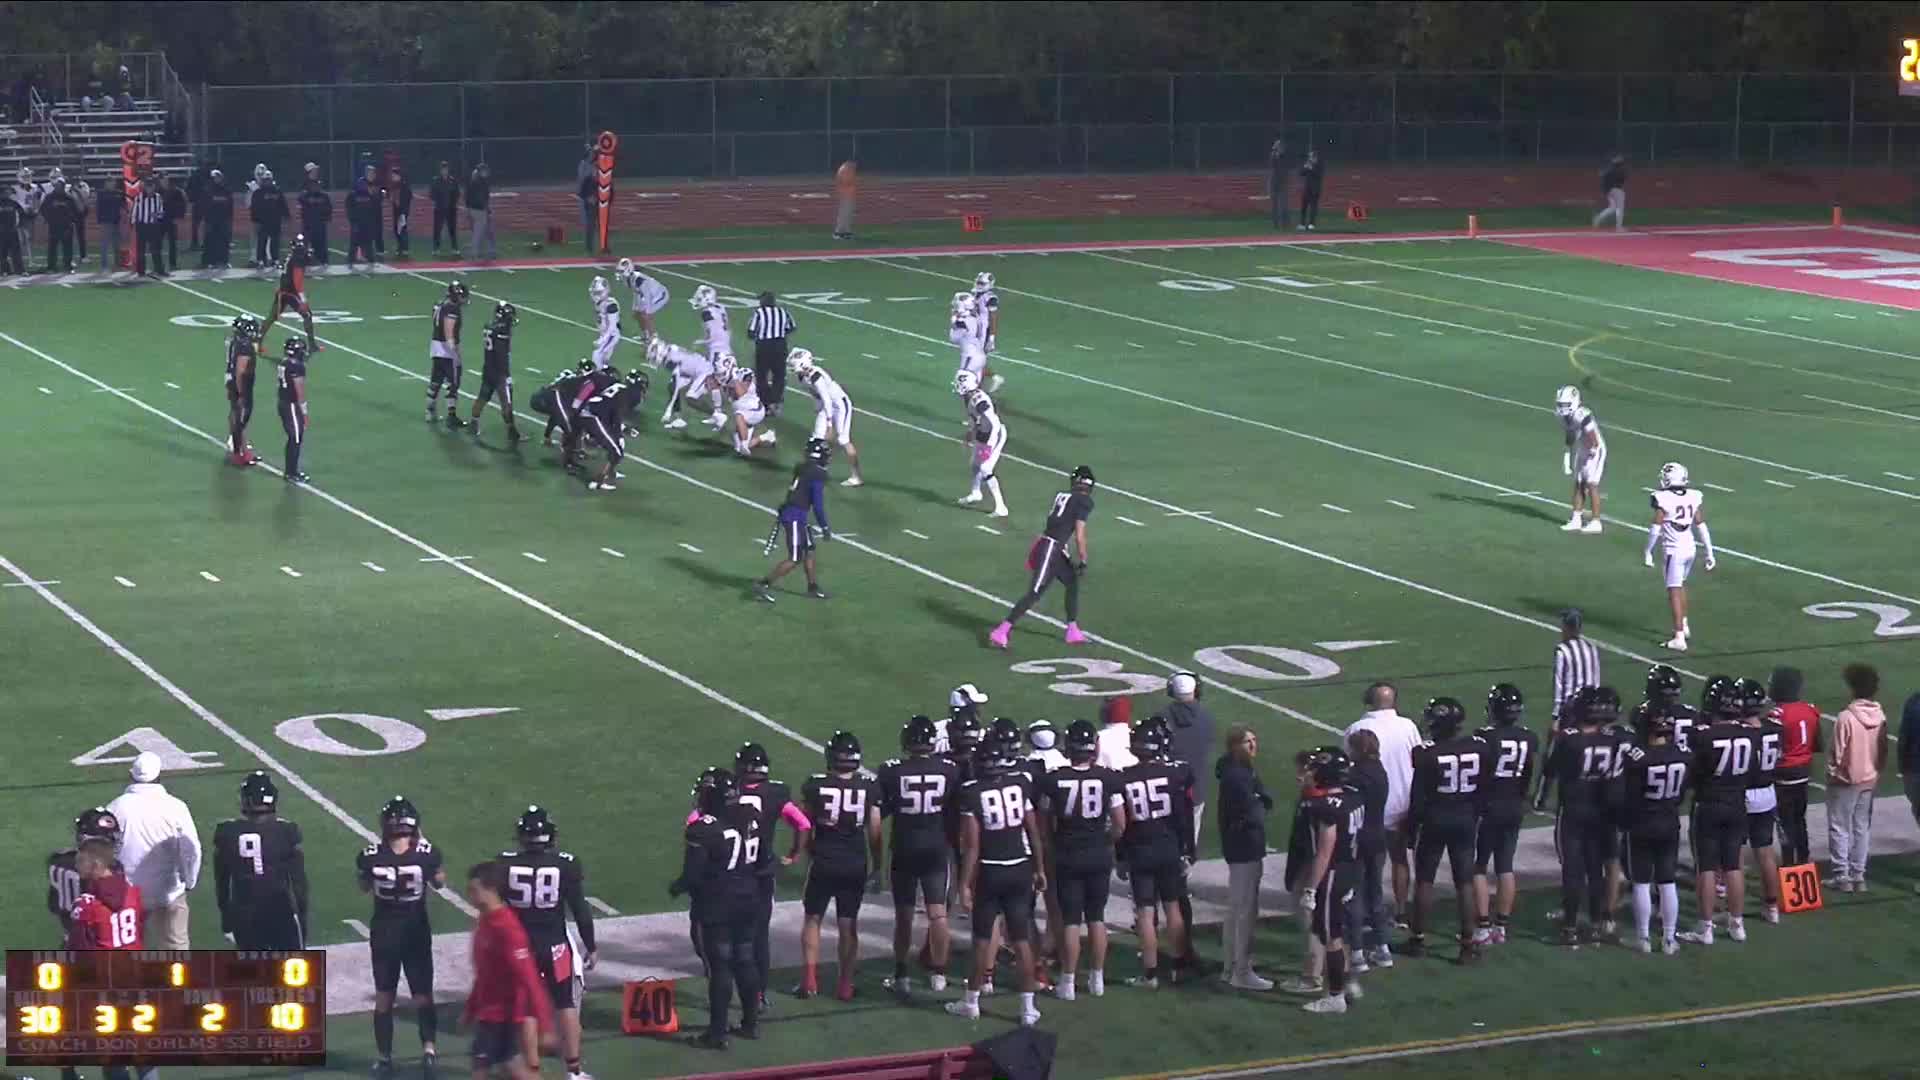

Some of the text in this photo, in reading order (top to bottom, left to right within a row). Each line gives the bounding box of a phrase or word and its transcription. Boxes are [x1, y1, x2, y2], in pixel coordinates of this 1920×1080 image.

[1901, 39, 1920, 81] 2
[1799, 719, 1808, 745] 1
[1437, 752, 1480, 793] 32
[1495, 740, 1529, 777] 21
[1712, 737, 1751, 776] 70
[900, 774, 946, 815] 52
[1057, 778, 1103, 819] 78
[1125, 777, 1172, 821] 85
[1645, 762, 1686, 800] 50
[818, 787, 867, 827] 34
[980, 785, 1025, 831] 88
[238, 833, 264, 875] 9
[372, 865, 423, 901] 23
[508, 866, 561, 909] 58
[1784, 870, 1818, 907] 30
[109, 907, 137, 947] 18
[630, 986, 672, 1026] 40
